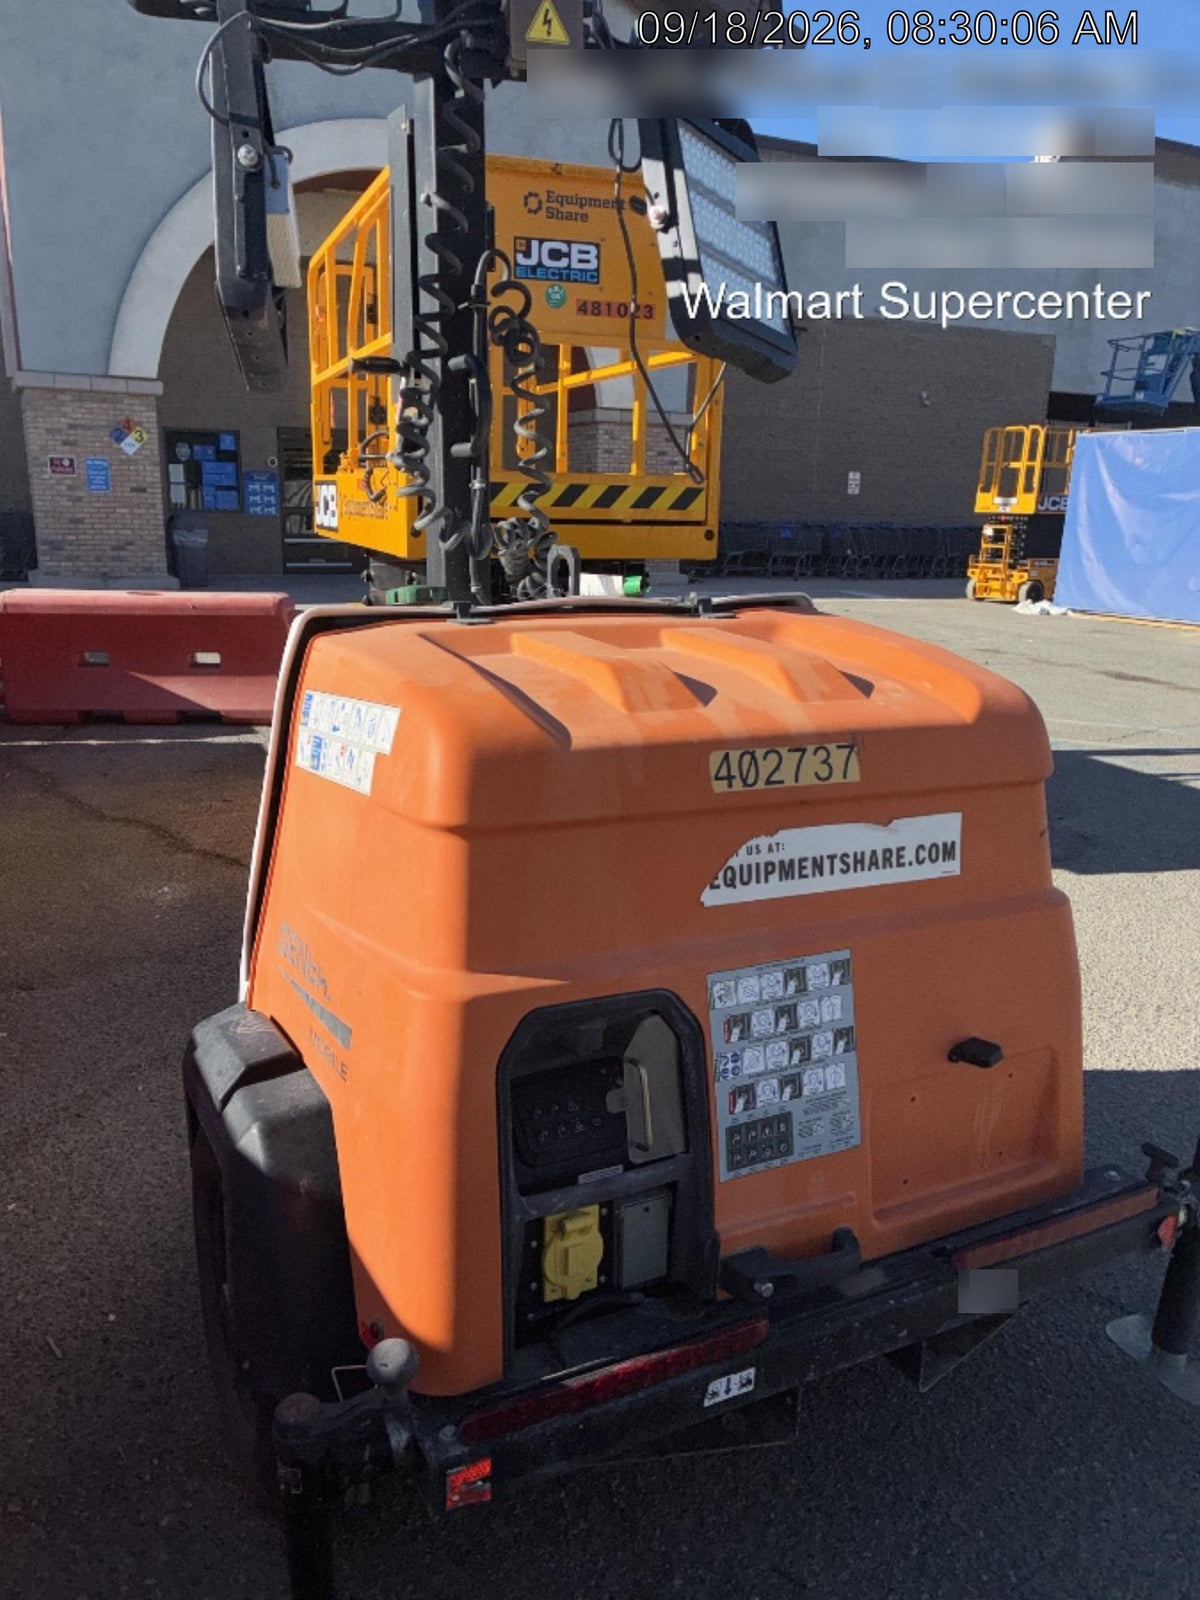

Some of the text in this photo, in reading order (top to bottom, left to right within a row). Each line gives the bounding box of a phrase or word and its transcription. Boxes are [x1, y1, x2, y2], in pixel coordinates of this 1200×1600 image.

[546, 190, 626, 210] Equipment
[546, 206, 589, 222] Share
[515, 239, 599, 270] JCB
[515, 266, 598, 282] ELECTRIC
[122, 419, 131, 431] 4
[134, 430, 144, 443] 3
[714, 744, 855, 788] 402737
[746, 844, 761, 856] US
[767, 842, 785, 854] AT:
[309, 1028, 348, 1082] MOBILE
